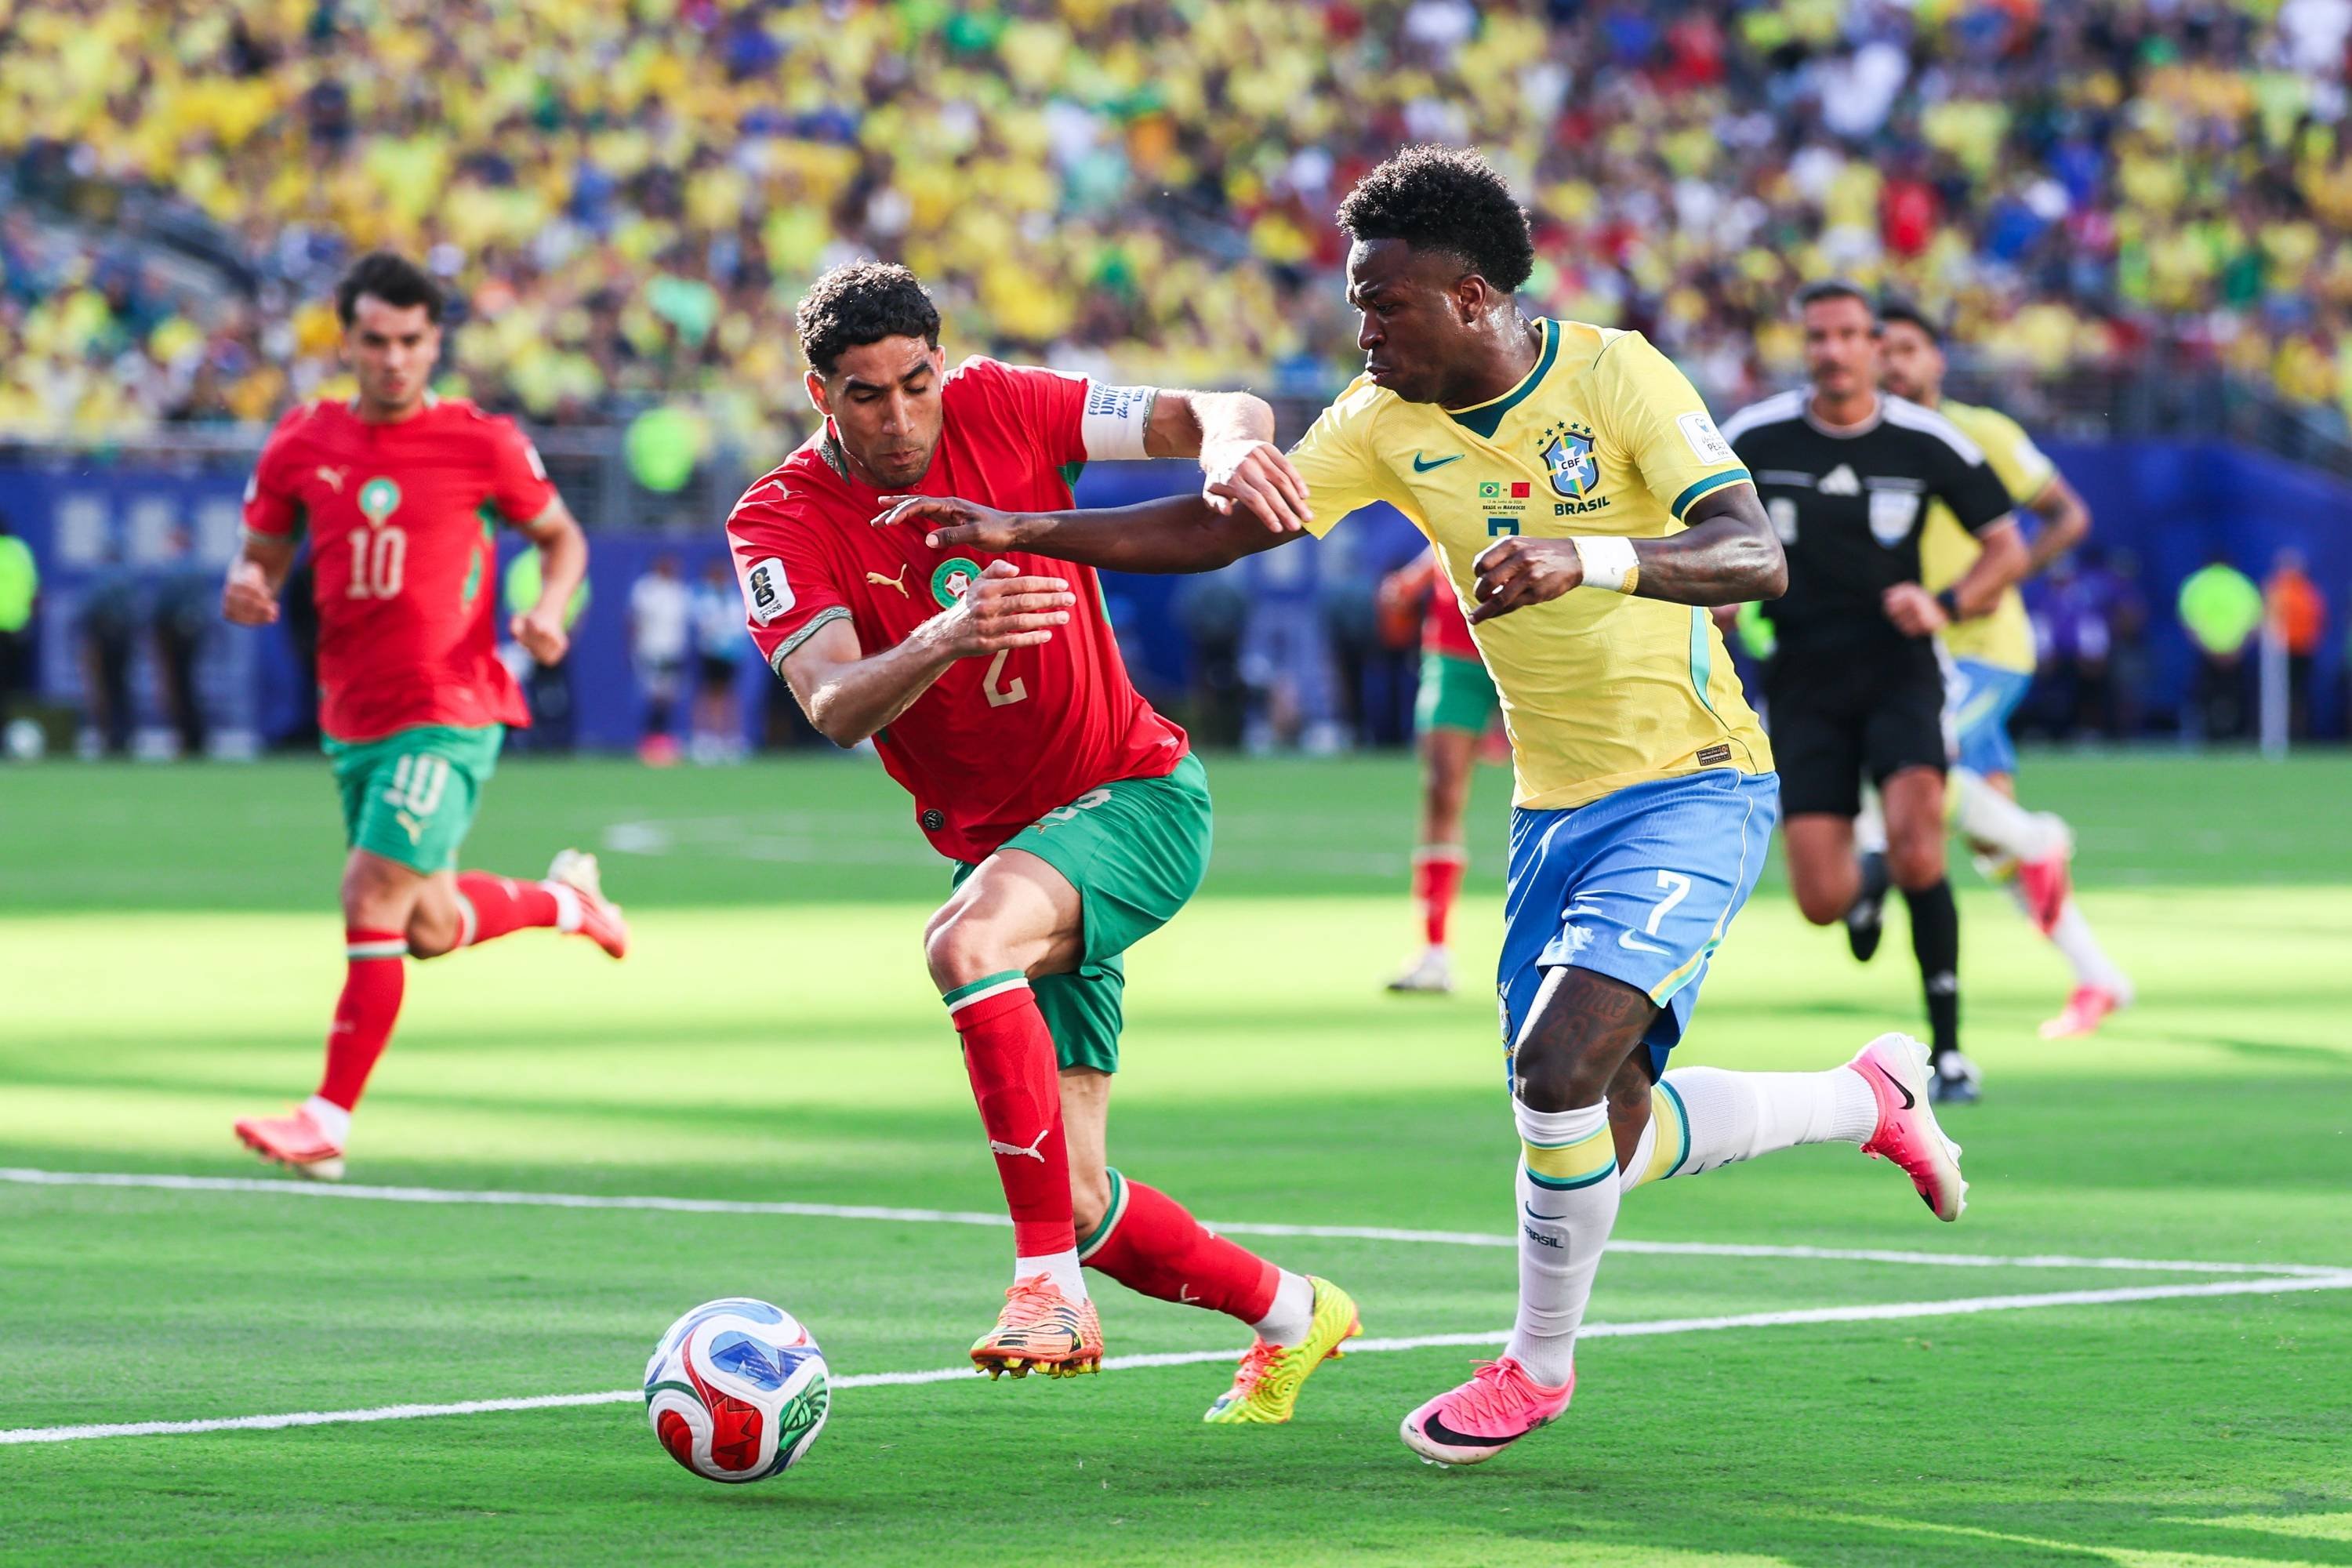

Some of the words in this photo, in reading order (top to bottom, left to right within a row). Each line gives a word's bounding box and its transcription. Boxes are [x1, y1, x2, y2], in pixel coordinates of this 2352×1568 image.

[1561, 458, 1581, 470] CBF
[1554, 496, 1610, 516] BRASIL
[346, 527, 407, 600] 10
[761, 603, 782, 619] 2026
[982, 648, 1028, 708] 2
[383, 753, 449, 817] 10
[1646, 869, 1691, 936] 7
